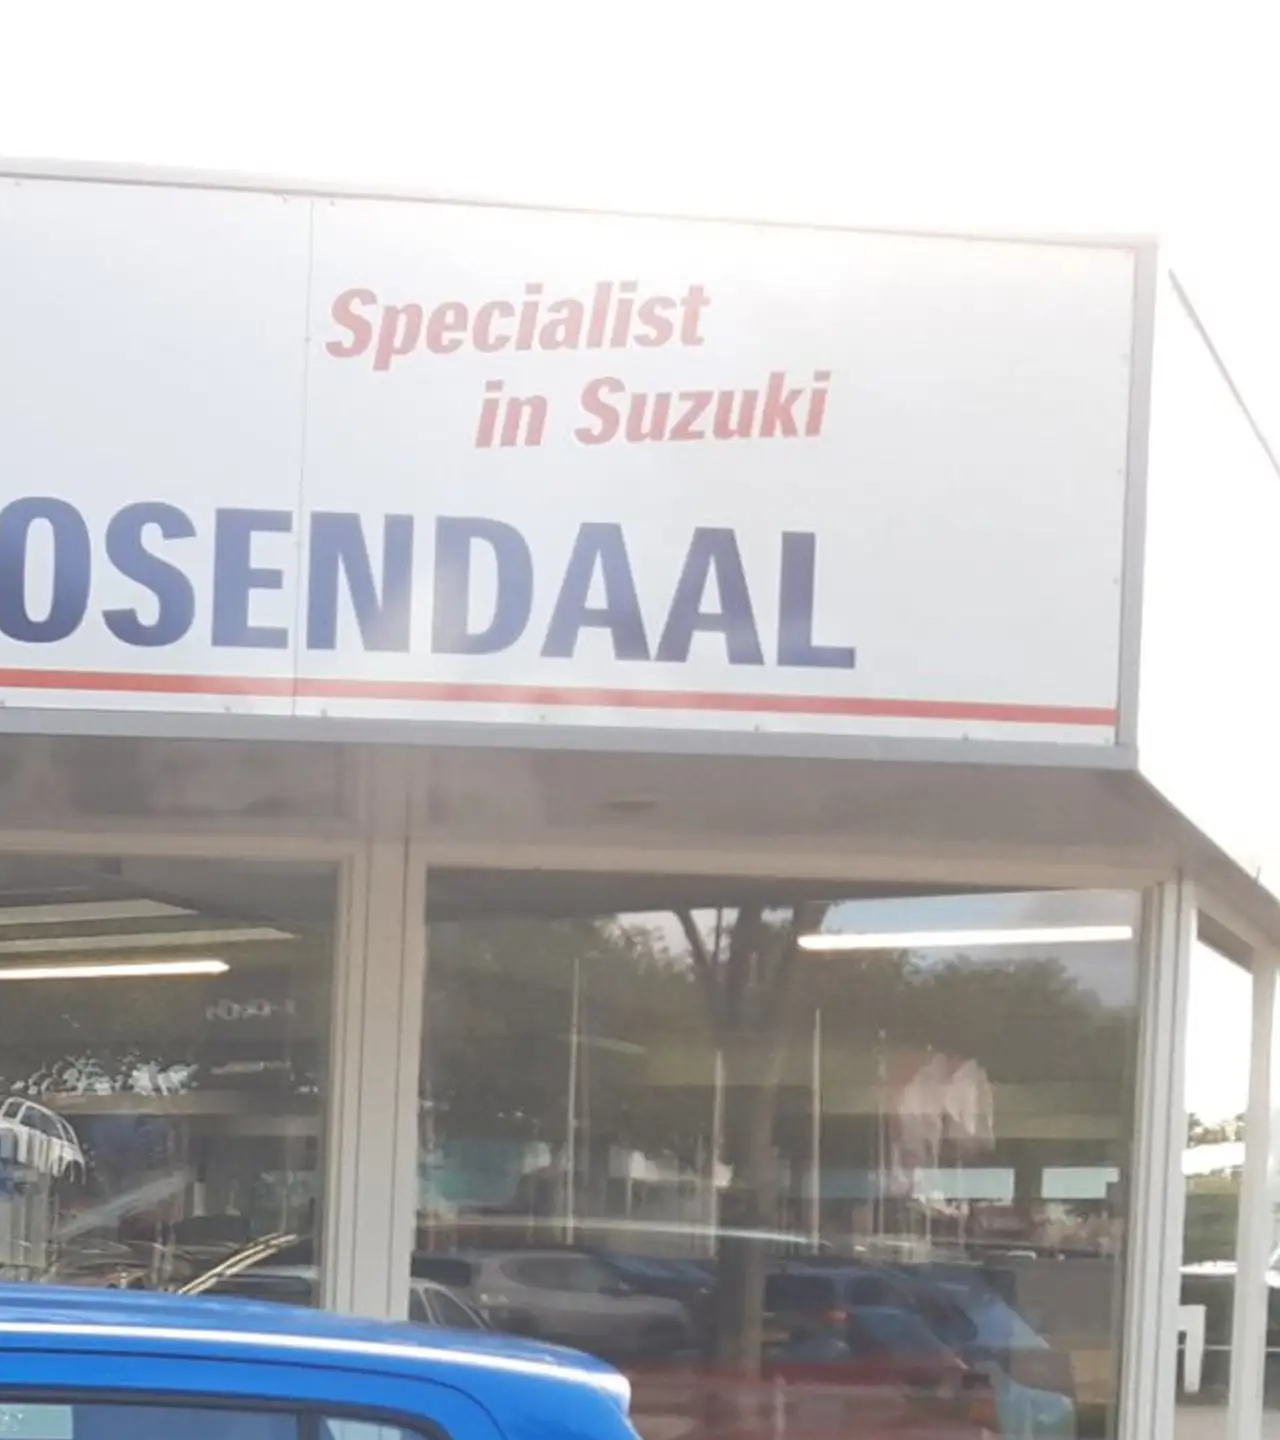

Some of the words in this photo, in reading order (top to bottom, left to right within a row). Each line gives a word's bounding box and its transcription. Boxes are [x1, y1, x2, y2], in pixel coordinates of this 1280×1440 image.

[325, 280, 711, 371] Specialist
[474, 378, 549, 449] in
[573, 369, 832, 445] Suzuki
